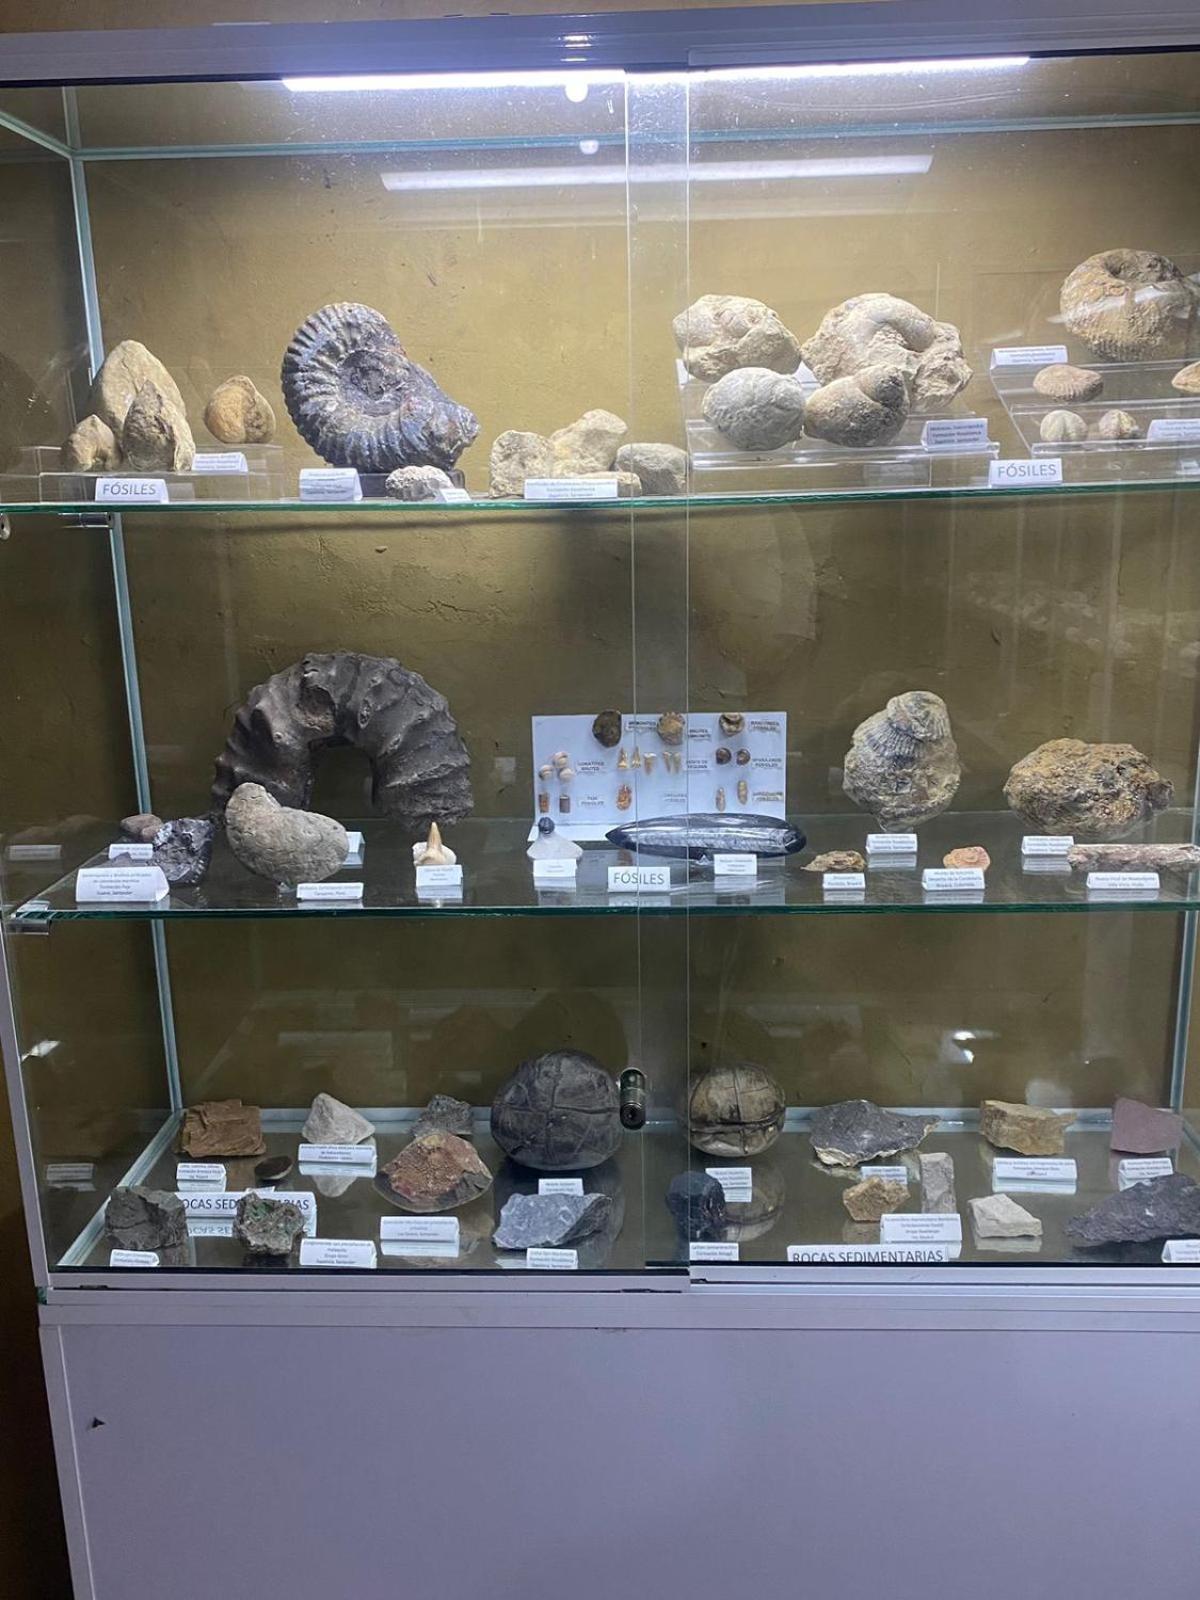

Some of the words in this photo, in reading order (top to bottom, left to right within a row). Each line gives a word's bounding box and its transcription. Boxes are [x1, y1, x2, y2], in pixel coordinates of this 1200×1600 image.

[998, 462, 1057, 479] FÓSILES
[102, 481, 156, 496] FÓSILES
[613, 870, 665, 885] FÓSILES
[182, 1198, 212, 1210] OCAS
[792, 1251, 836, 1263] ROCAS
[838, 1249, 944, 1263] SEDIMENTARIAS
